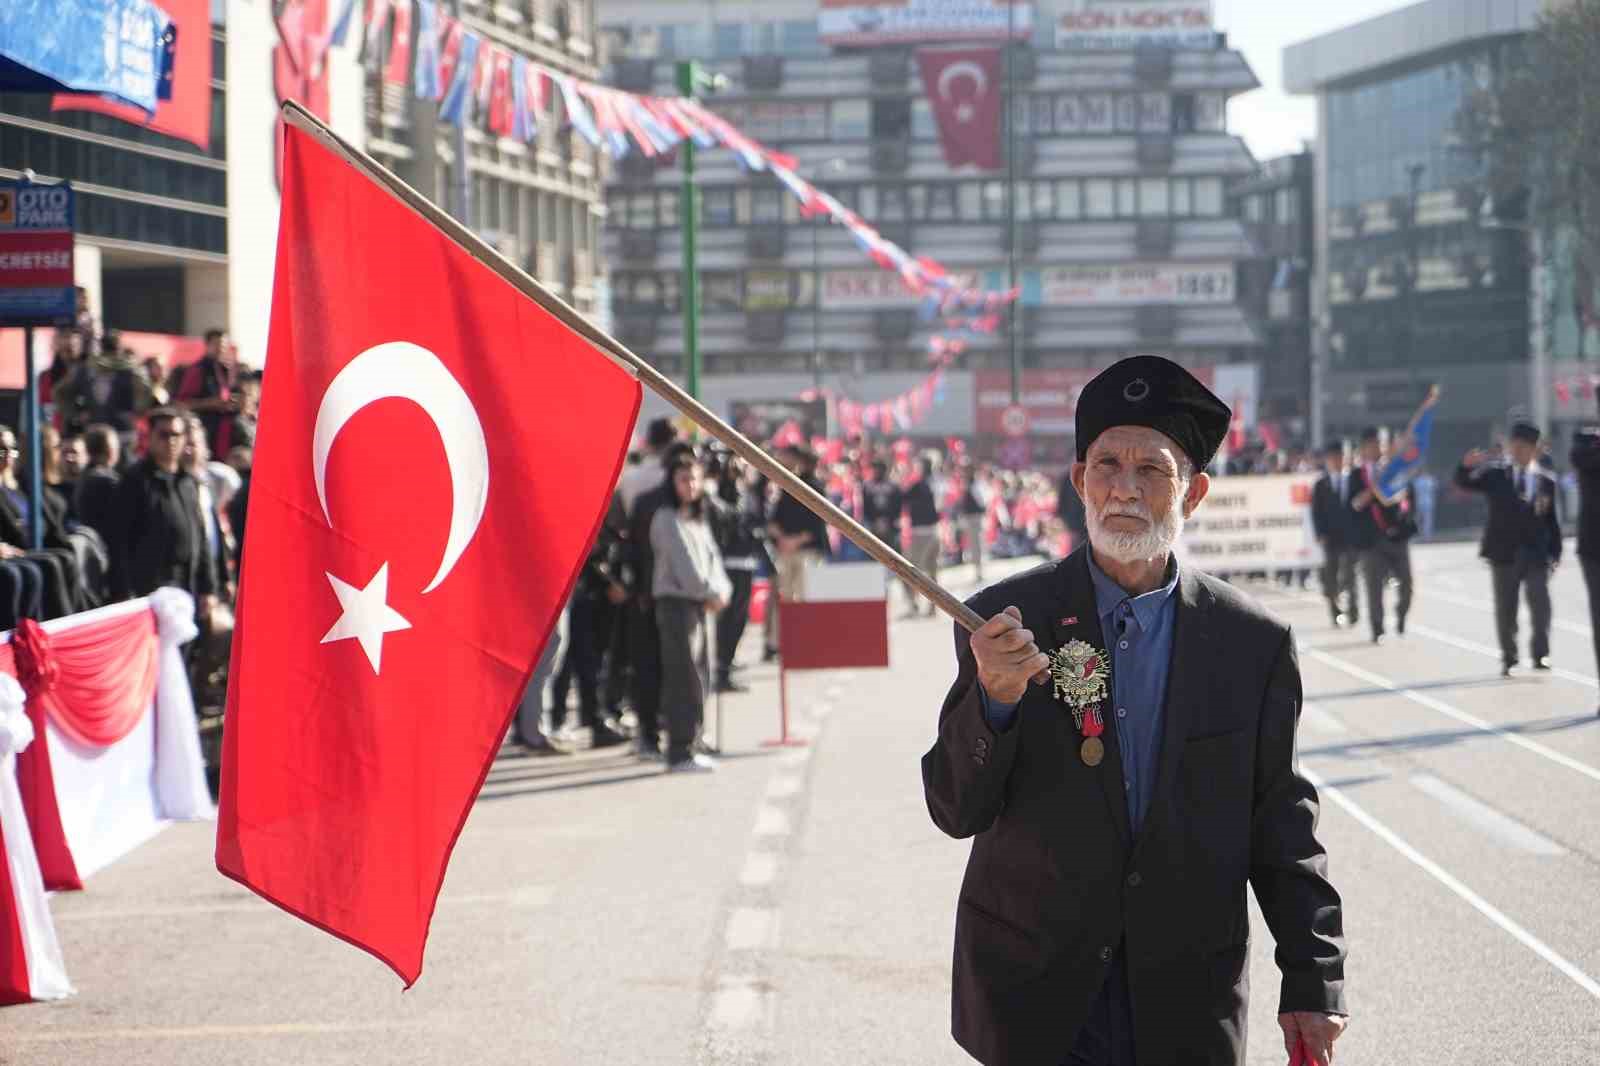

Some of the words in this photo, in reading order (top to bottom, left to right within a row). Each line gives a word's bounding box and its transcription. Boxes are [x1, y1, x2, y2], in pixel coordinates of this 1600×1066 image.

[1058, 11, 1115, 29] SON
[18, 188, 68, 210] OTO
[19, 210, 67, 225] PARK
